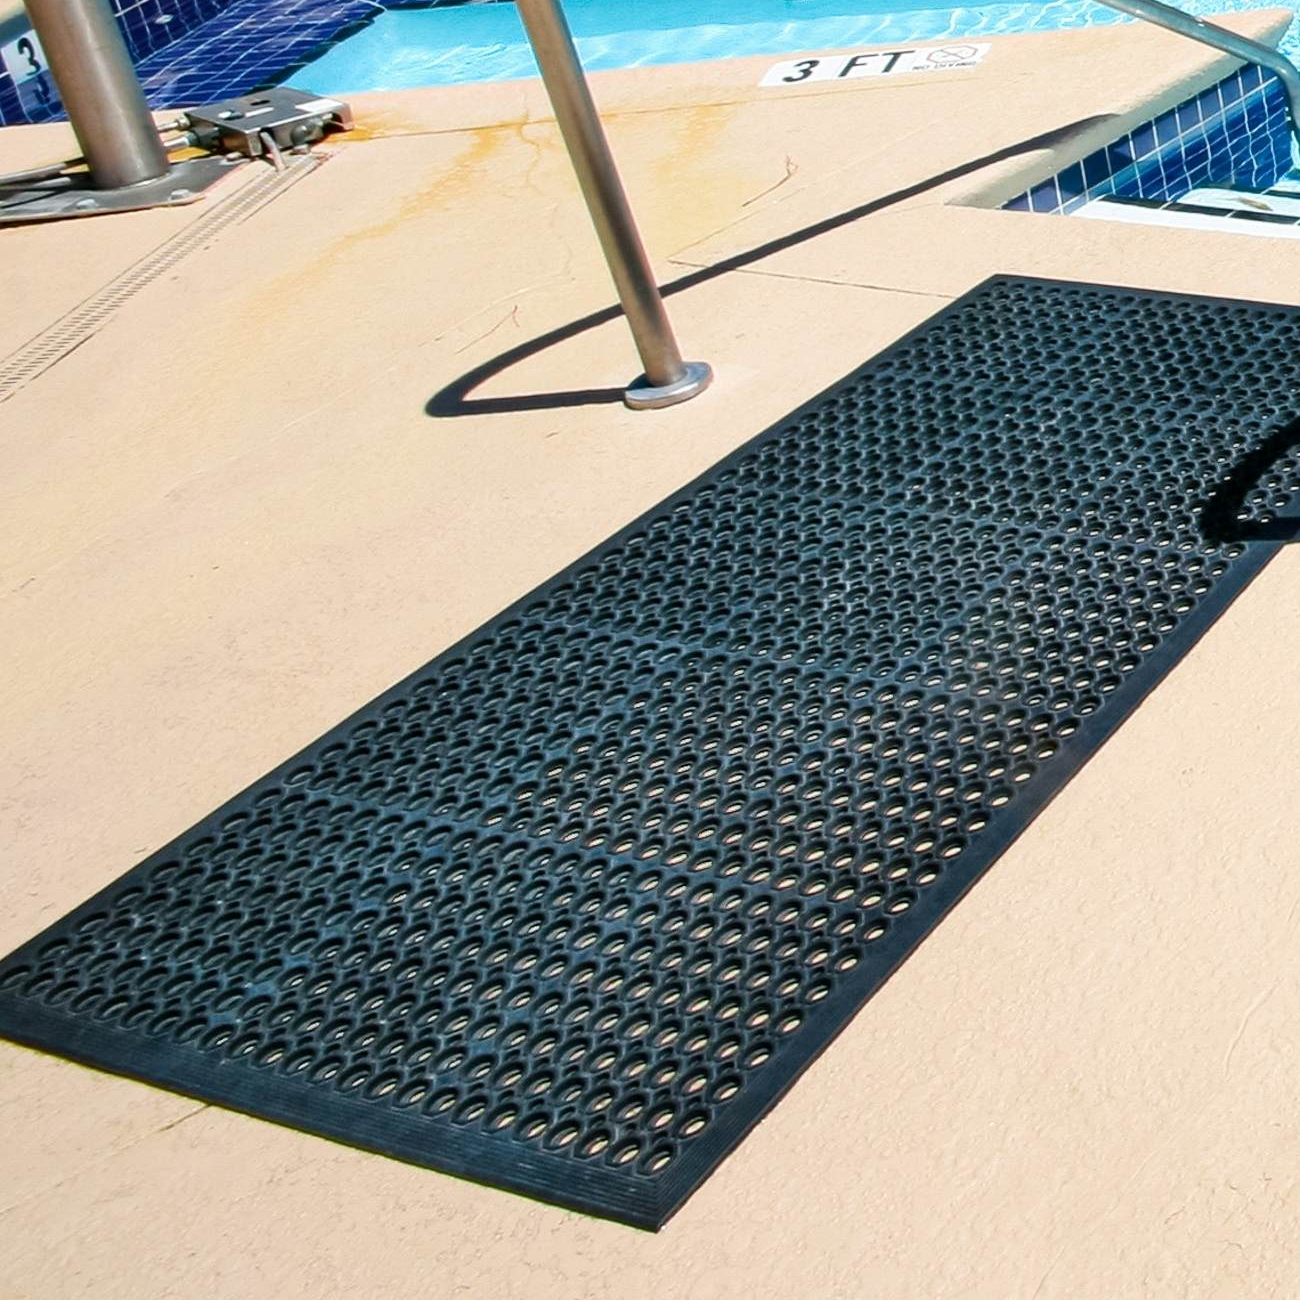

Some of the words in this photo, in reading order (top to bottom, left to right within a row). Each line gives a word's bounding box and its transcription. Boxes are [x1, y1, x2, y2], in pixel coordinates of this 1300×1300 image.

[17, 37, 42, 77] 3
[782, 59, 820, 82] 3
[838, 50, 915, 78] FT
